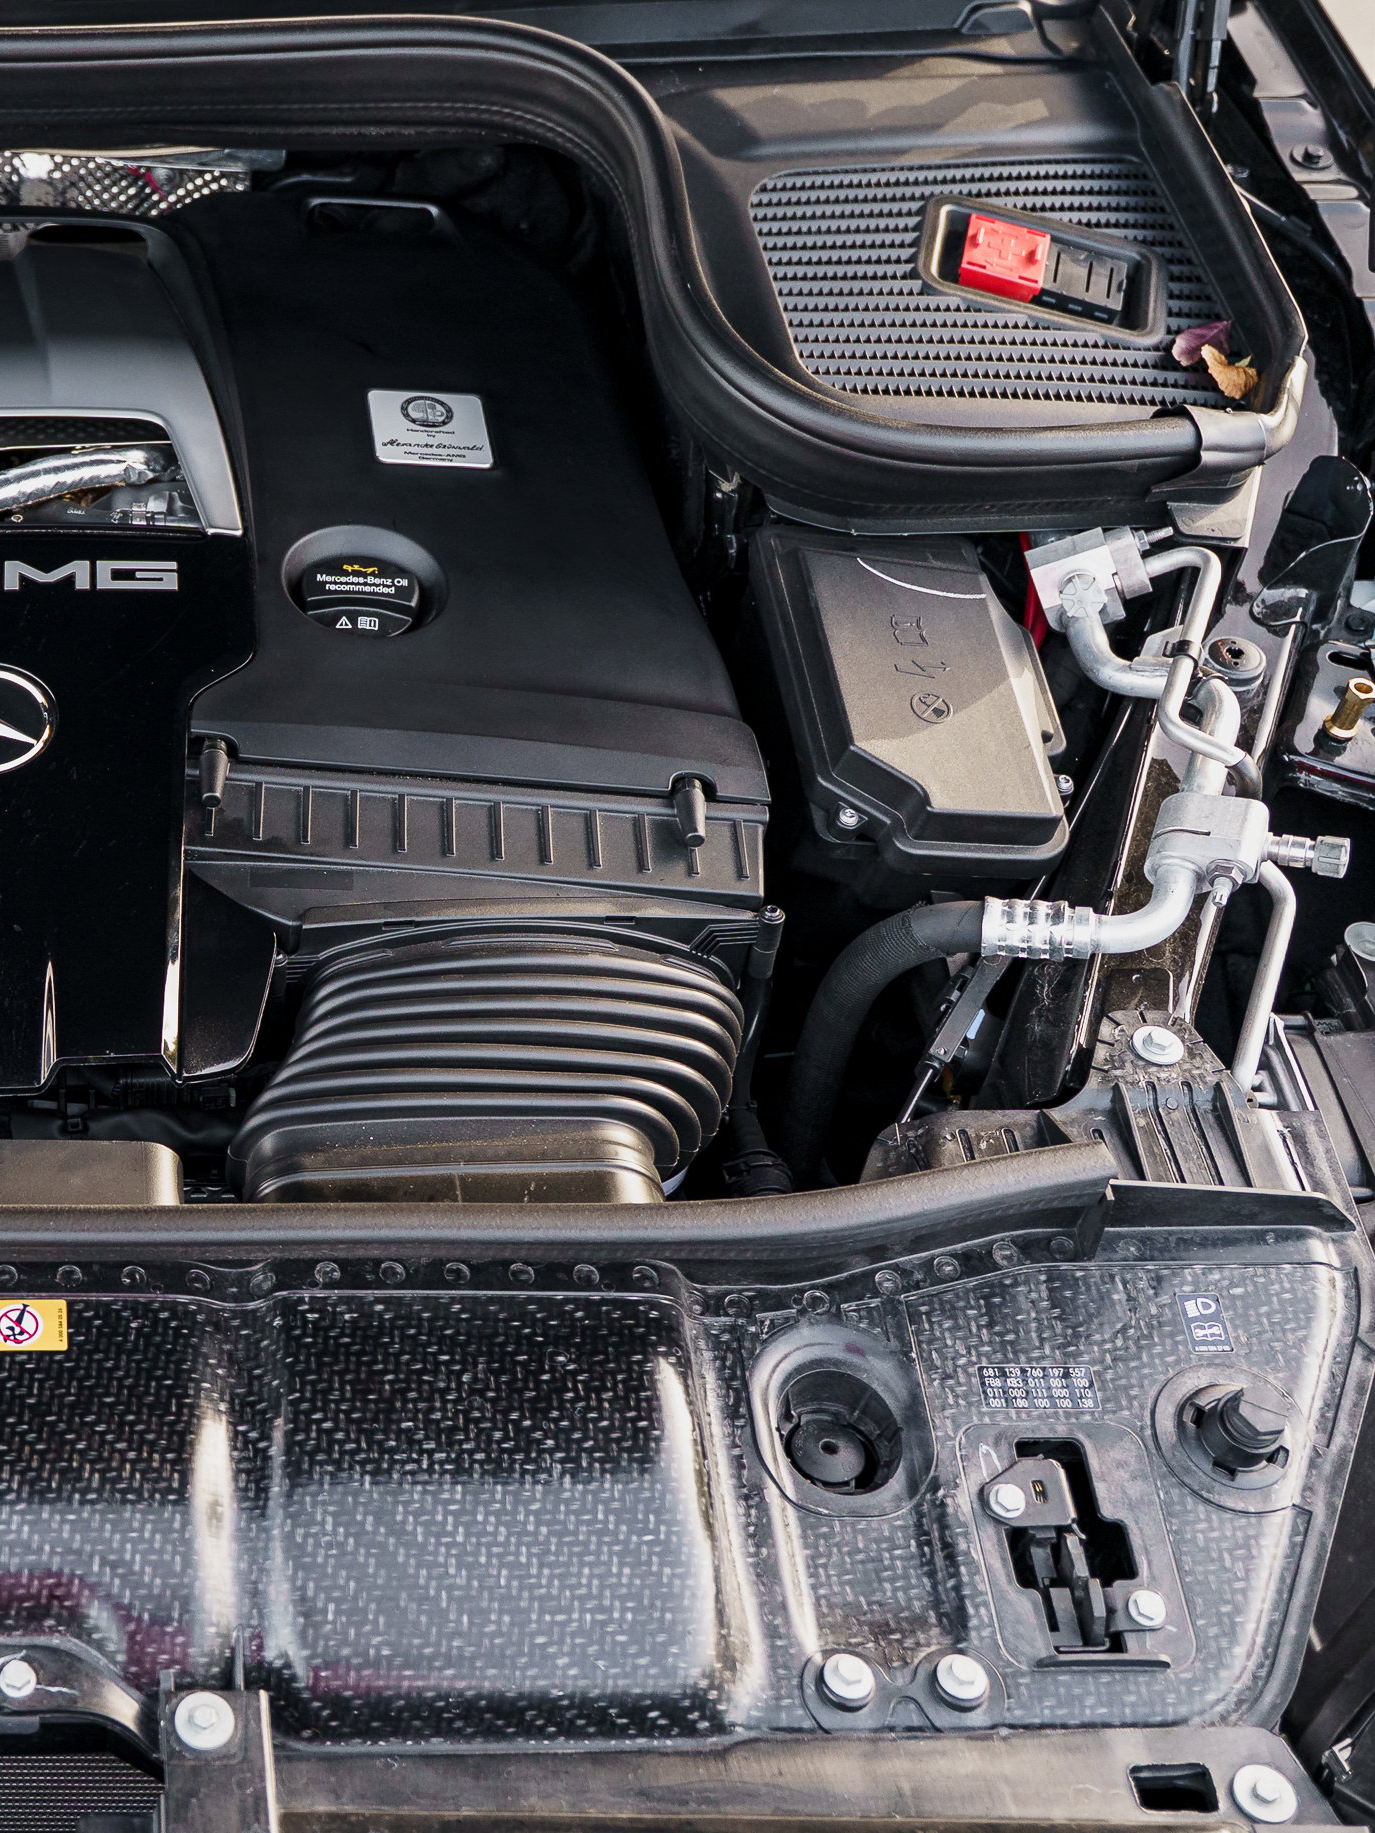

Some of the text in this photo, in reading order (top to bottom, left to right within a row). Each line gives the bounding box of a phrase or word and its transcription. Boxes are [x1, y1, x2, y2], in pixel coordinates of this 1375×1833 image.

[404, 451, 466, 459] Mercedes-AMG
[317, 574, 408, 587] Mercedes-Benz Oil
[326, 584, 395, 594] recommended
[982, 1368, 1086, 1377] 681 139 760 197 557
[1027, 1378, 1045, 1388] 011
[1049, 1378, 1066, 1388] 001
[1072, 1378, 1089, 1388] 100
[986, 1388, 1004, 1398] 011
[1008, 1388, 1026, 1398] 000
[1031, 1388, 1048, 1398] 111
[1052, 1388, 1069, 1398] 000
[989, 1398, 1094, 1408] 001 100 100 100 138
